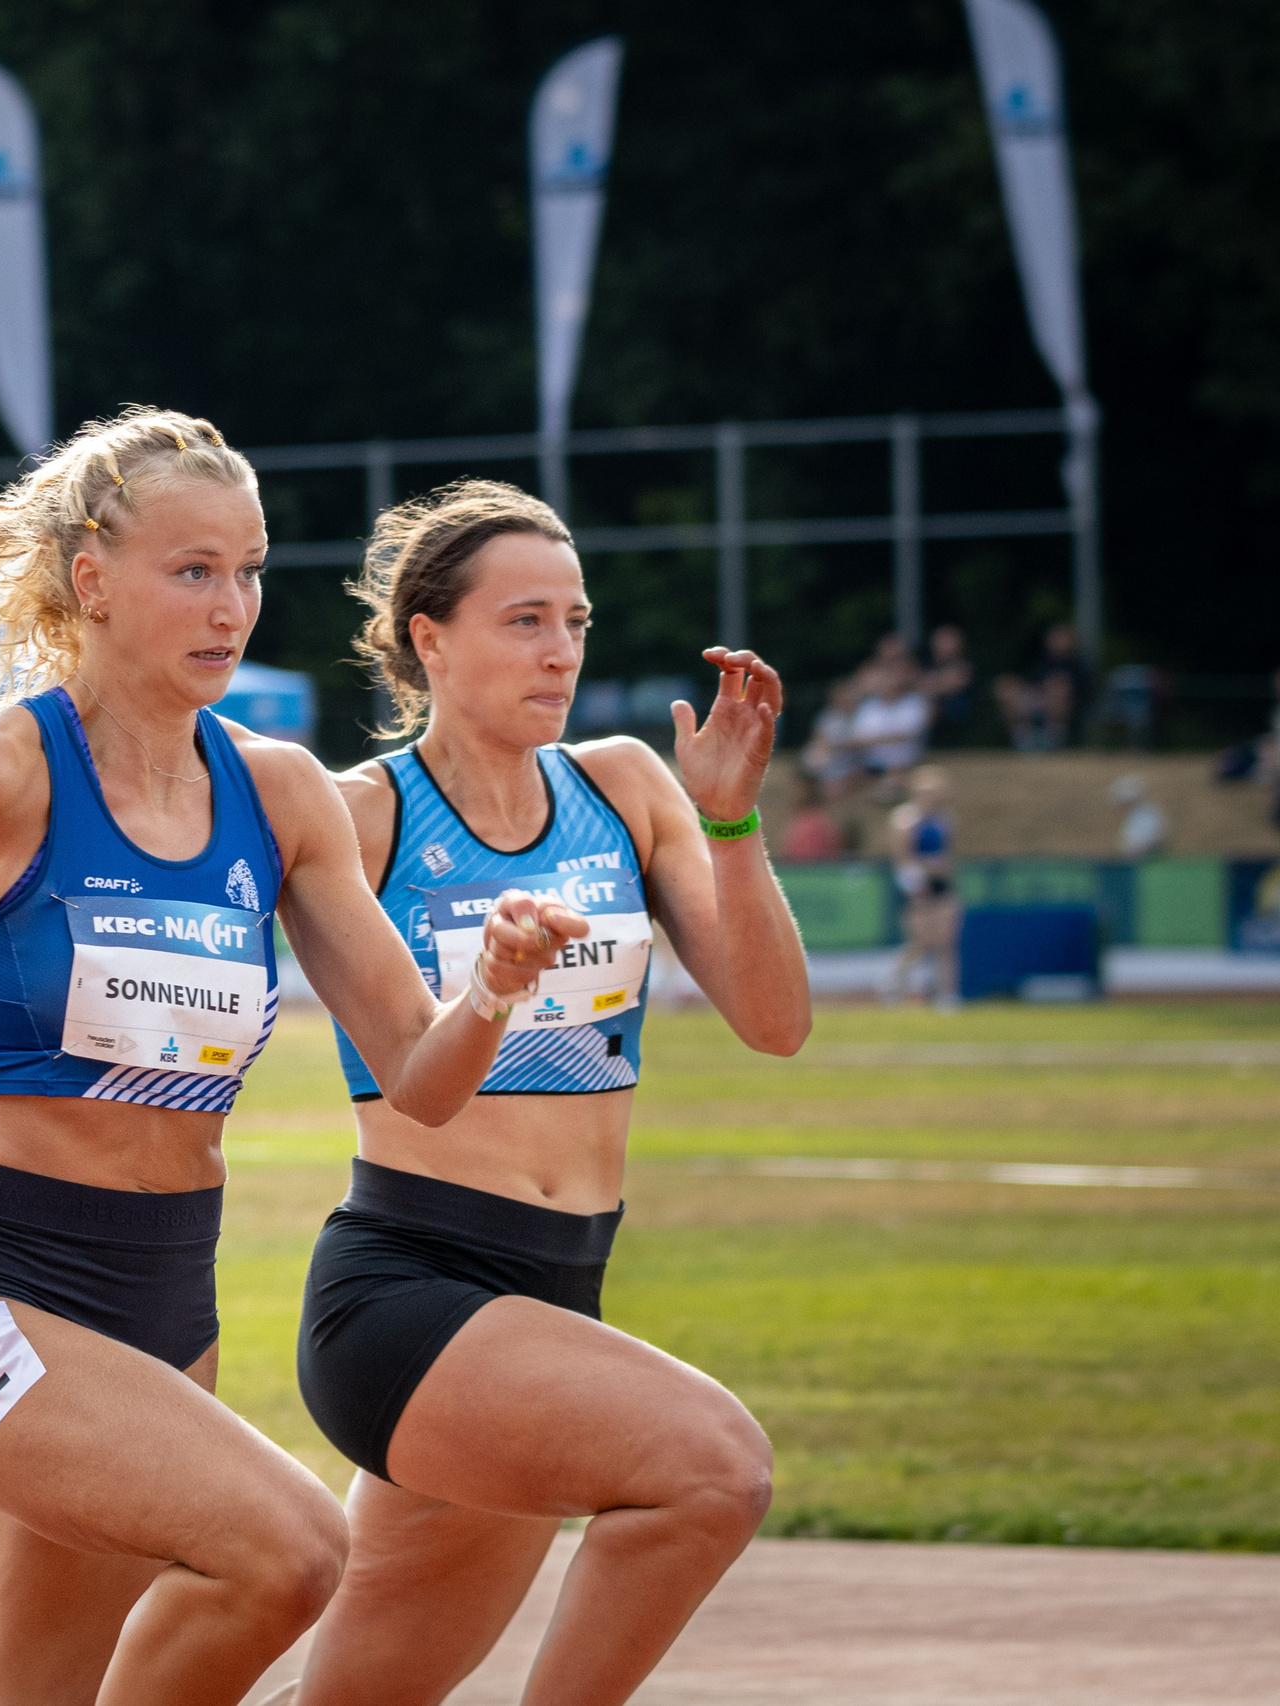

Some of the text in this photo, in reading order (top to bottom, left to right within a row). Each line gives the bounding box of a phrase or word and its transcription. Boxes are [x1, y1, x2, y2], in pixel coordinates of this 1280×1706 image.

[84, 877, 130, 890] CRAFT
[105, 978, 240, 1015] SONNEVILLE
[534, 1012, 565, 1022] KBC
[160, 1053, 177, 1063] KBC
